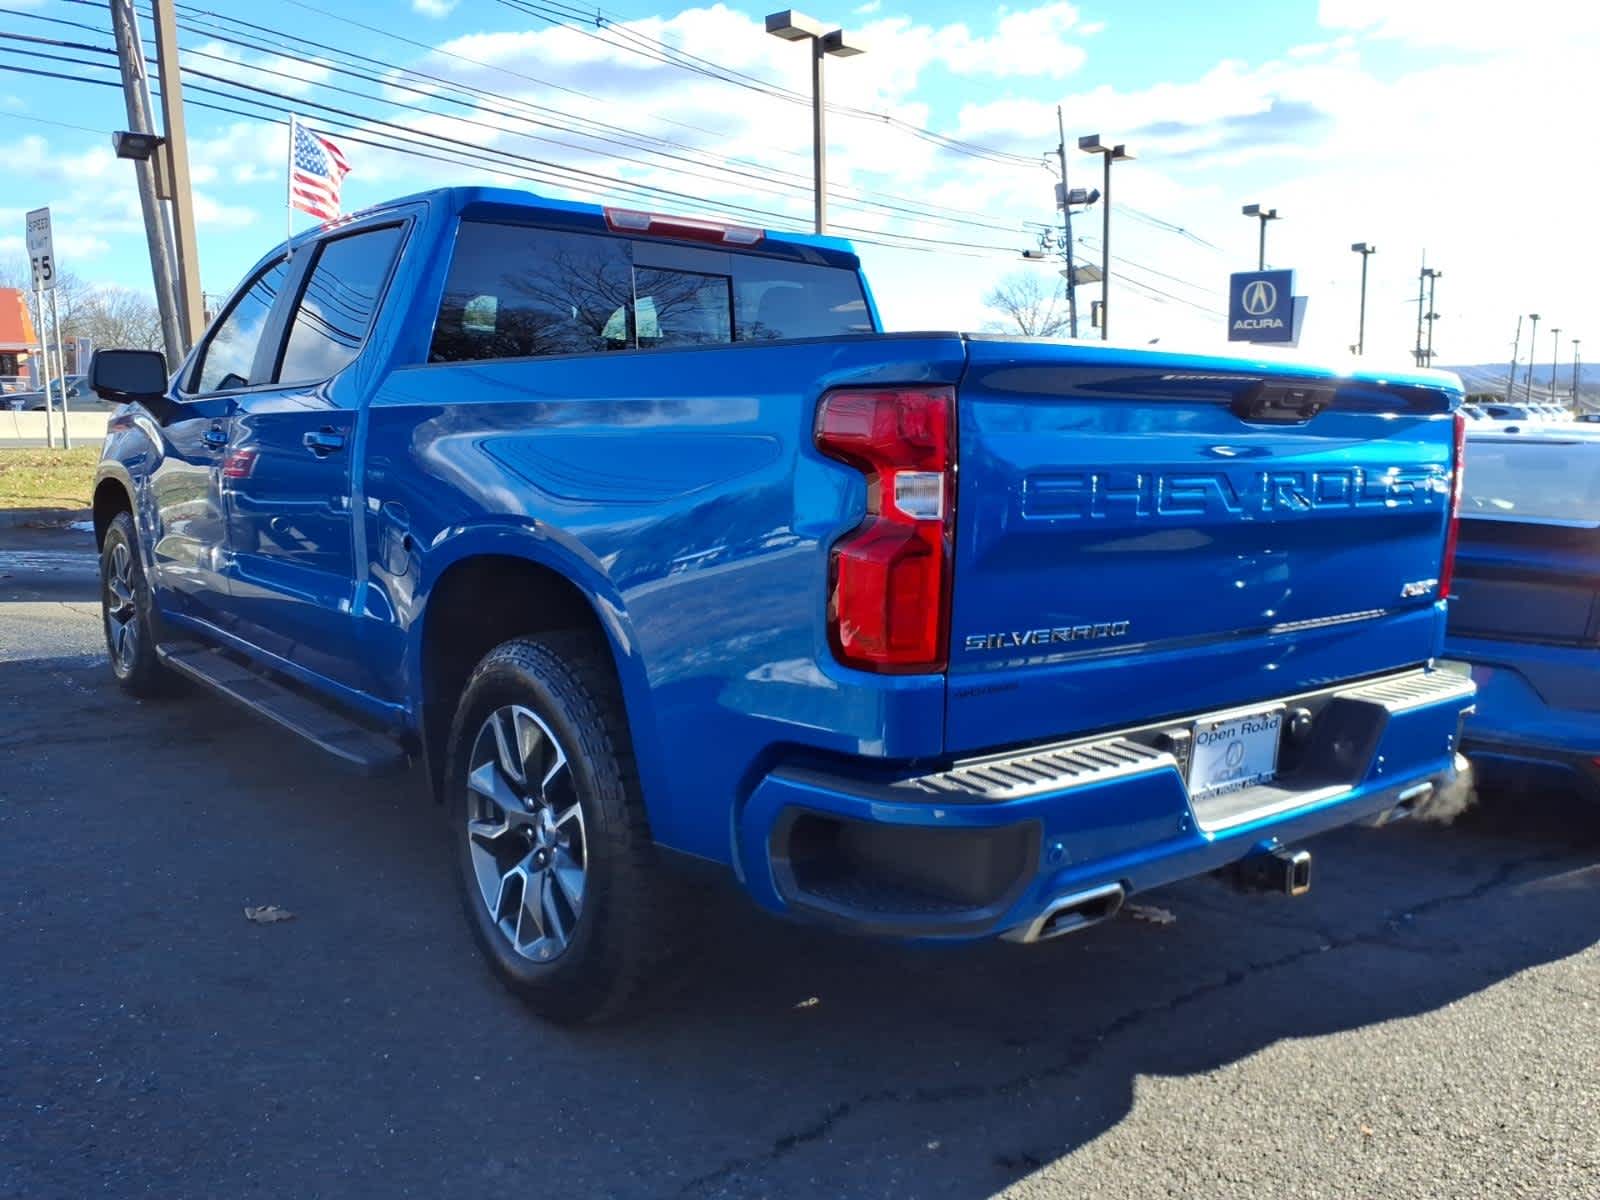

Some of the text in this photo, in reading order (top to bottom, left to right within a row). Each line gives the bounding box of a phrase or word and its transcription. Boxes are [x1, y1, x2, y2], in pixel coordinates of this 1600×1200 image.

[28, 218, 48, 233] SPEED
[1233, 318, 1284, 330] ACURA
[1020, 466, 1450, 520] CHEVROLET
[964, 620, 1131, 652] SILVERADO
[1197, 719, 1278, 746] Open Road
